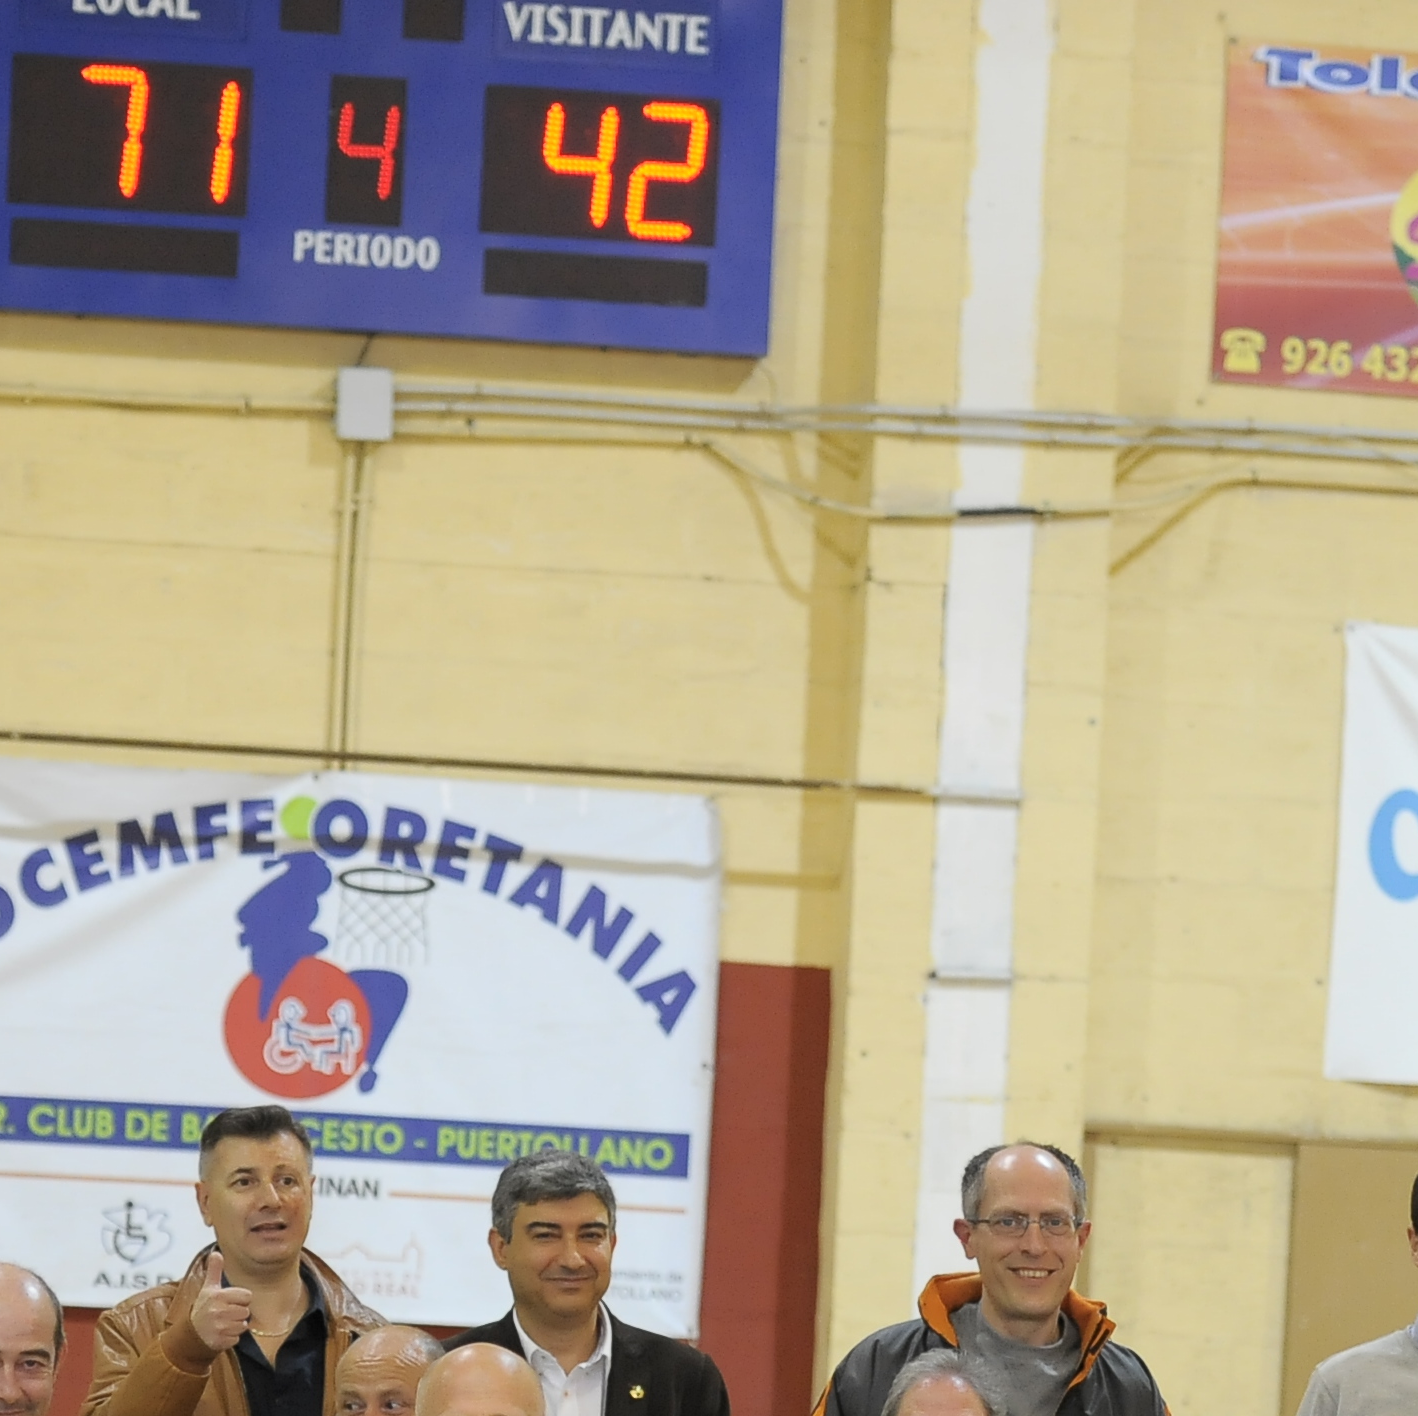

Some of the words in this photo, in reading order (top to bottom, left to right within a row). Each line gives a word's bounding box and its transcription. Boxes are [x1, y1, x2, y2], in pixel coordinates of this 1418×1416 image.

[502, 2, 710, 55] VISITANTE
[81, 64, 242, 204] 71
[337, 102, 400, 200] 4
[543, 102, 709, 241] 42
[292, 230, 440, 271] PERIODO
[1279, 336, 1353, 380] 926
[312, 797, 698, 1037] ORETANIA
[27, 1103, 116, 1140] CLUB
[124, 1108, 171, 1143] DE
